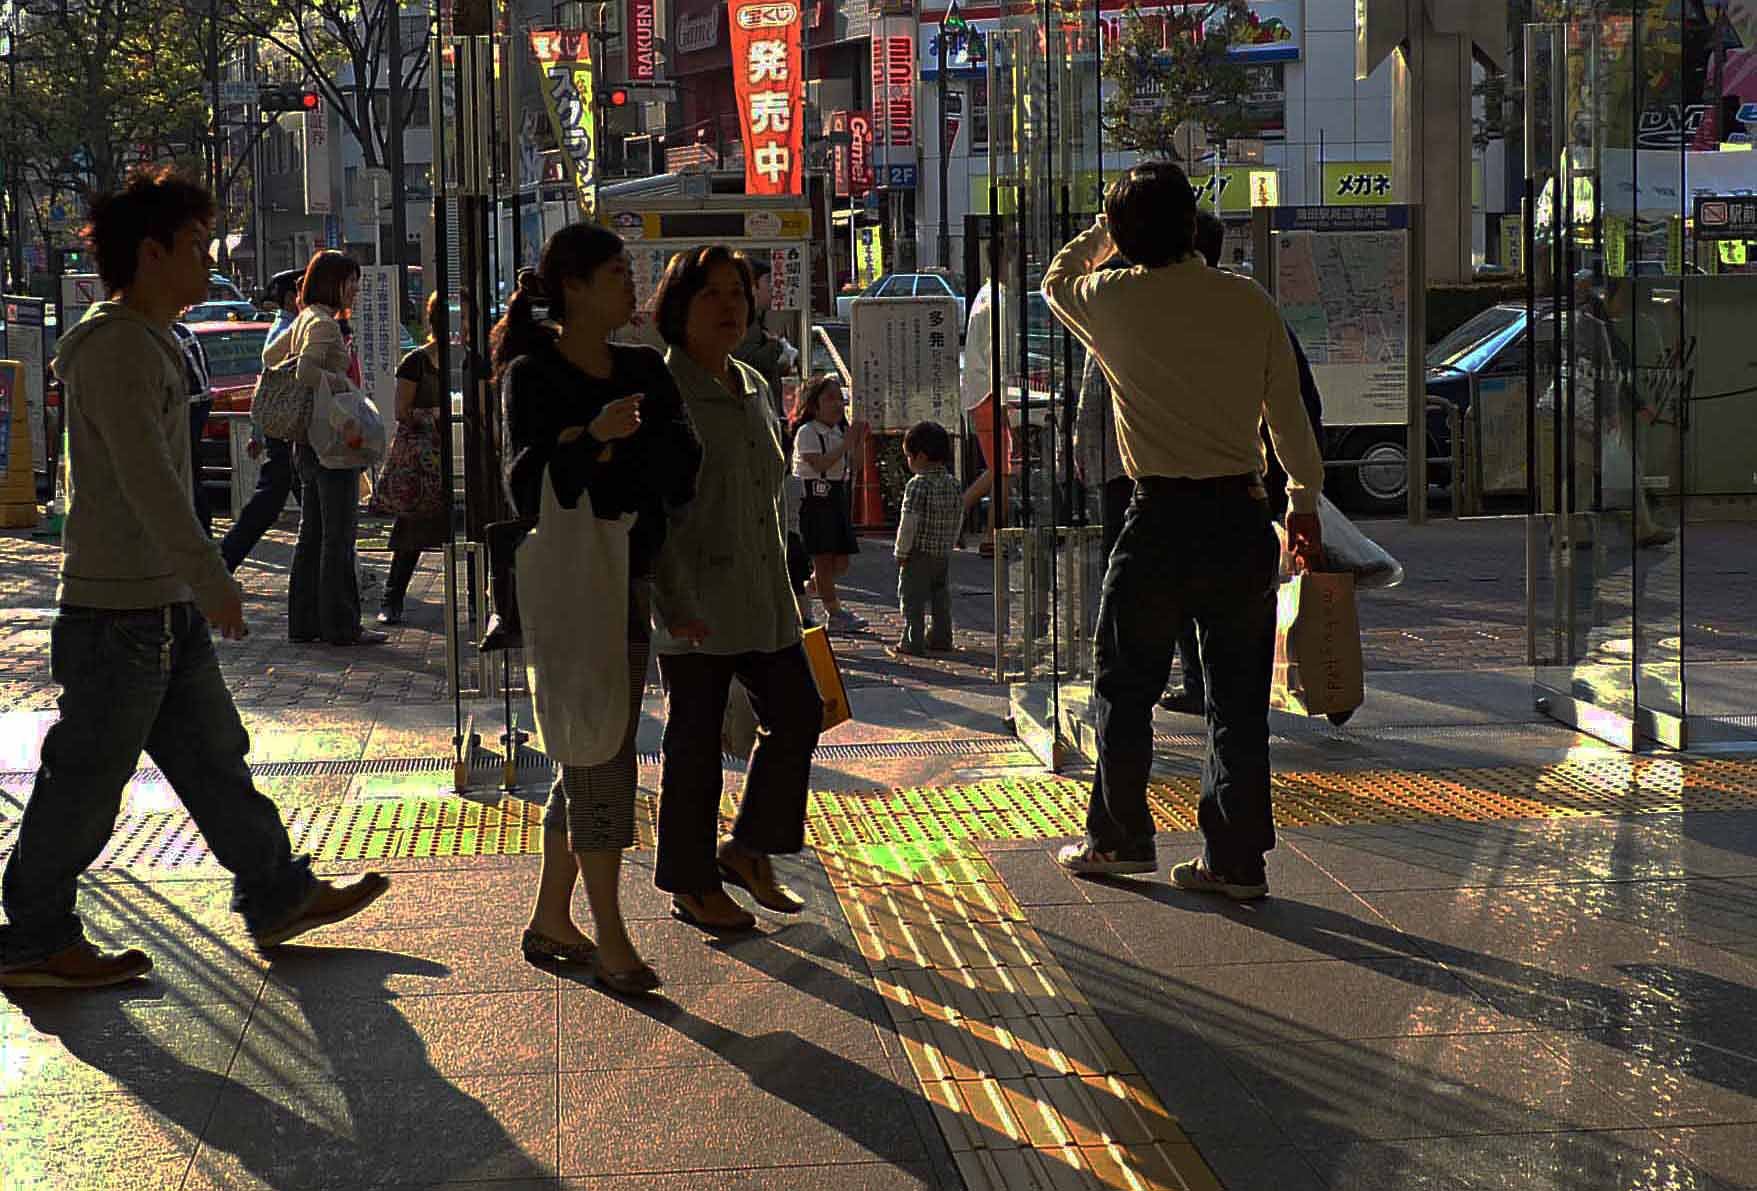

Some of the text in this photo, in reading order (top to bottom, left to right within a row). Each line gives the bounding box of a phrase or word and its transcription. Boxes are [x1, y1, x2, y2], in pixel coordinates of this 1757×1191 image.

[636, 4, 654, 77] RAKUEN
[748, 38, 791, 184] 発売中
[891, 167, 913, 184] 2F
[1336, 173, 1391, 197] メガネ
